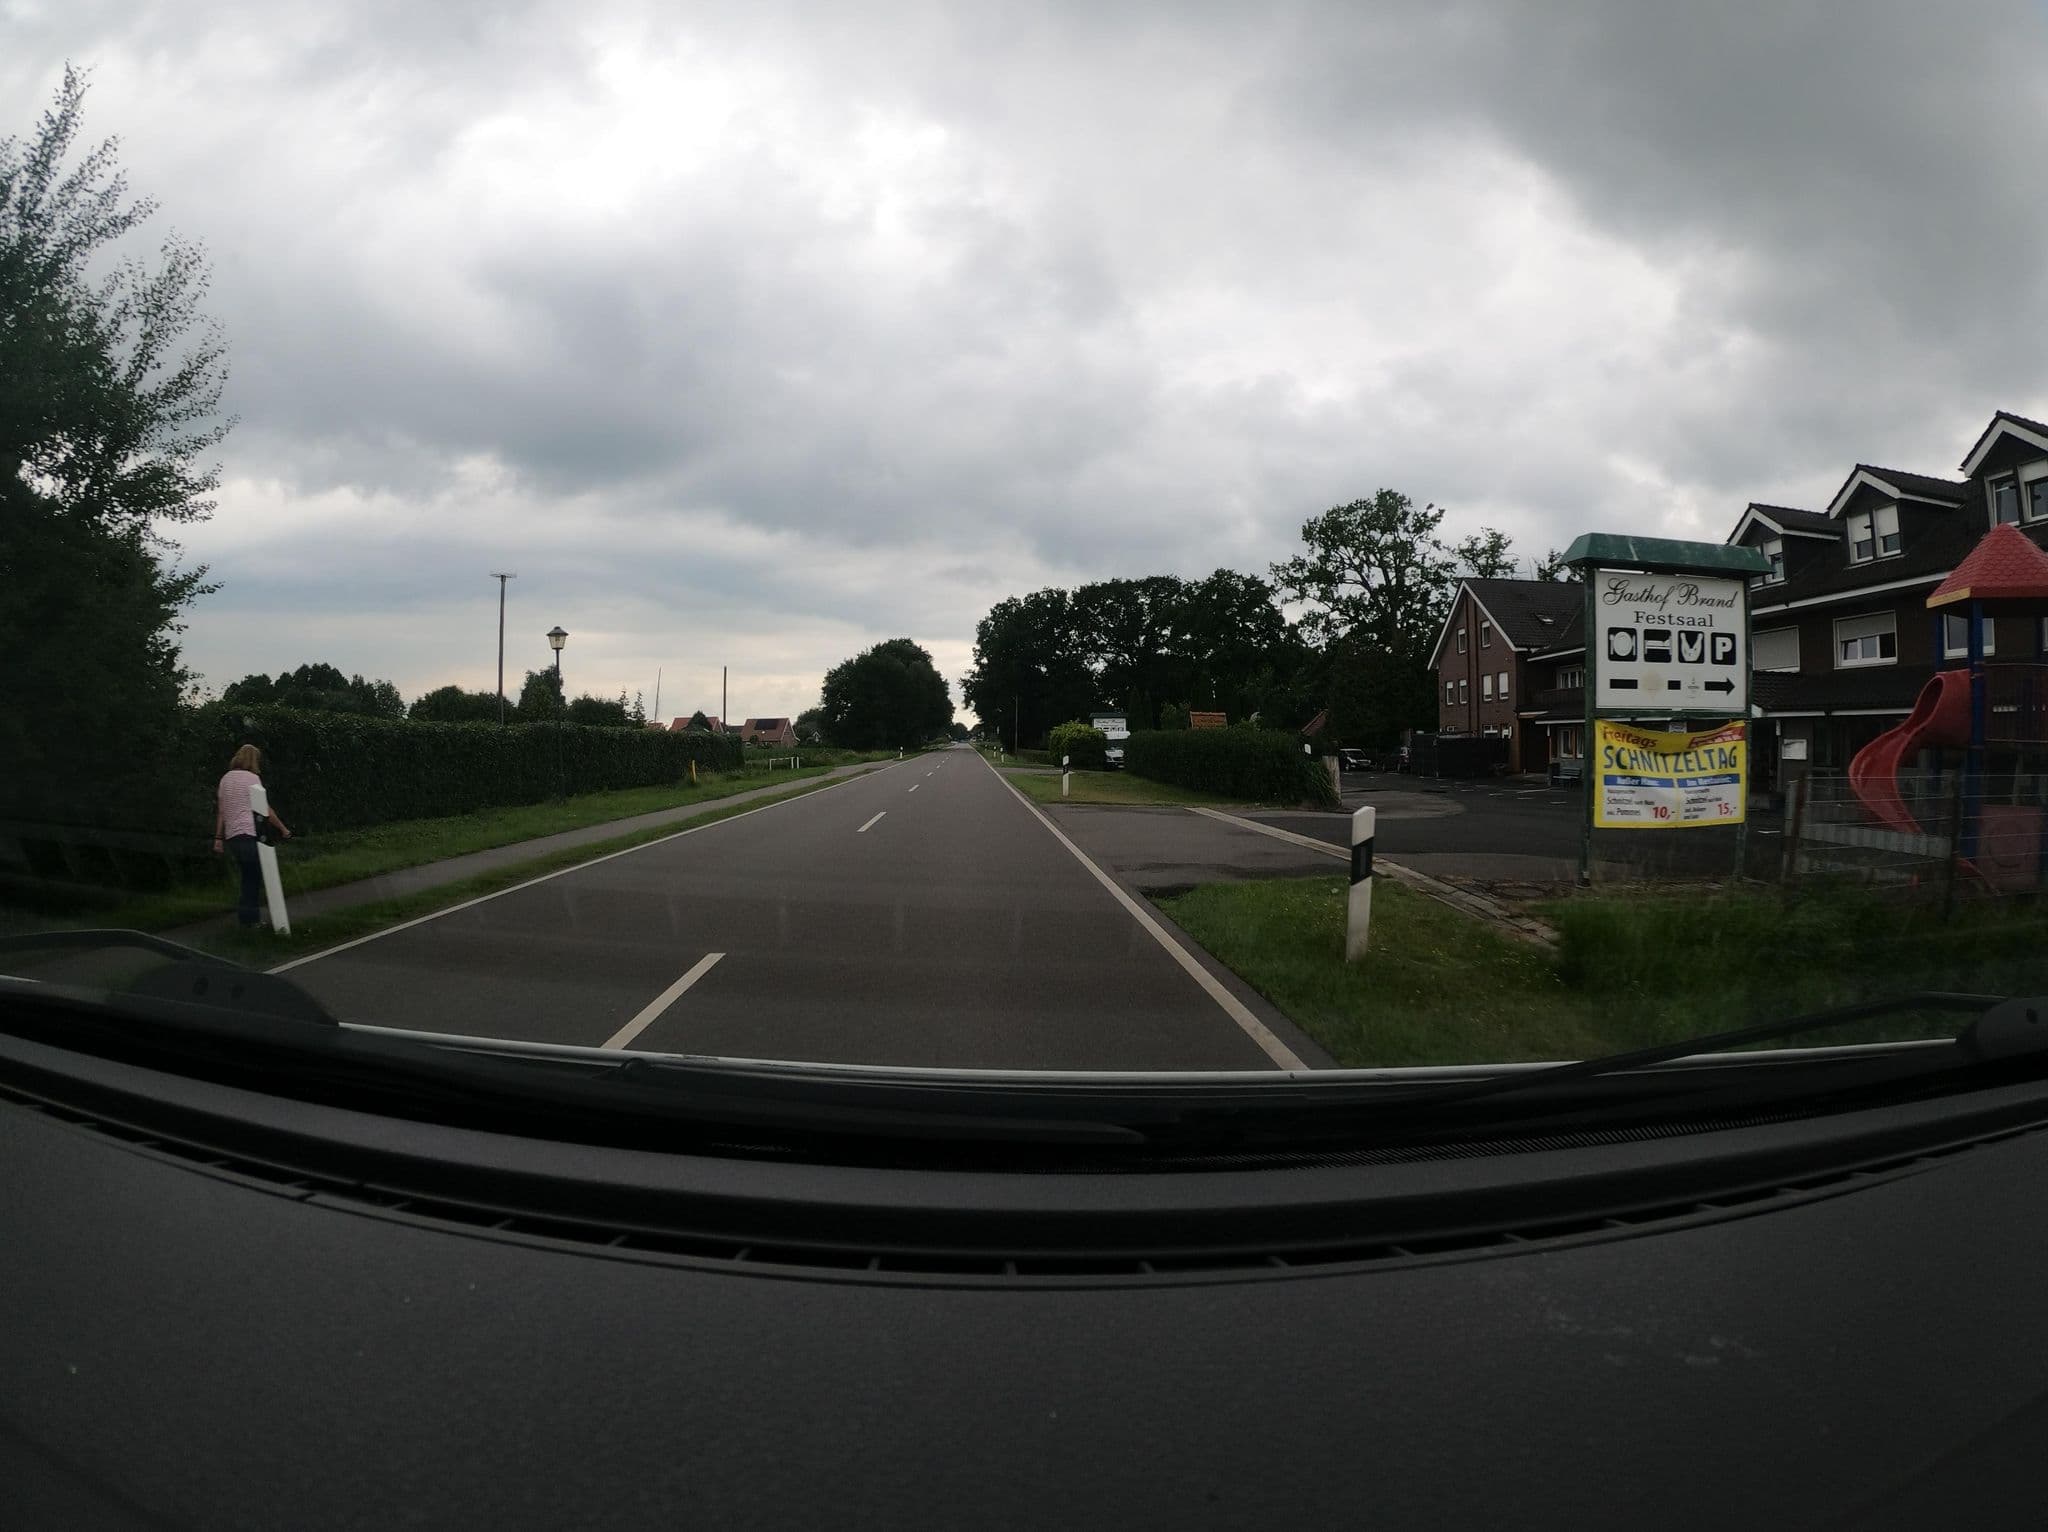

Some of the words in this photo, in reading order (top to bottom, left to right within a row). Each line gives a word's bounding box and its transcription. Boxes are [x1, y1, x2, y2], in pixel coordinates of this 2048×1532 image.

[1603, 577, 1675, 611] Gasthof
[1676, 582, 1739, 609] Brand
[1634, 611, 1714, 627] Festsaal
[1603, 746, 1737, 773] SCHNITZELTAG
